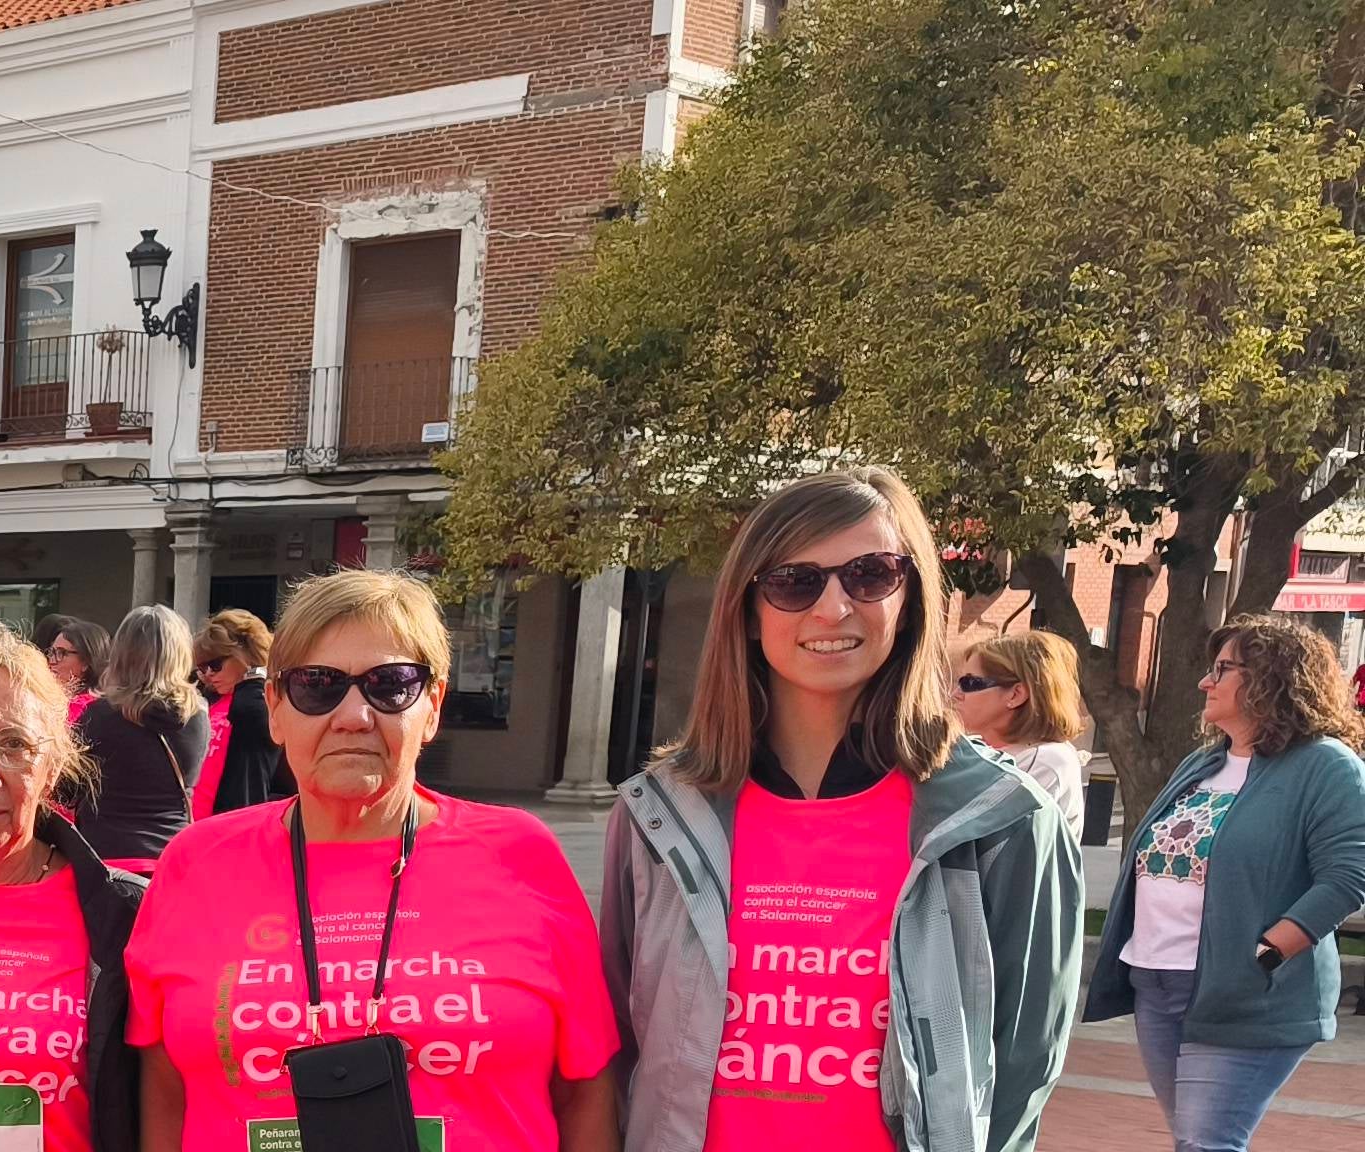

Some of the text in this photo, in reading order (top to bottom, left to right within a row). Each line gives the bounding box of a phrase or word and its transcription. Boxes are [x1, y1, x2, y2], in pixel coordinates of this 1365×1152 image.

[746, 884, 877, 900] asociación española
[744, 897, 783, 907] contra
[786, 897, 798, 907] el
[741, 909, 833, 923] en Salamanca
[237, 958, 293, 985] En
[434, 983, 490, 1024] el
[46, 1026, 85, 1063] el
[717, 1027, 883, 1089] ánce
[259, 1128, 300, 1139] Peñaran
[259, 1139, 302, 1150] contra e
